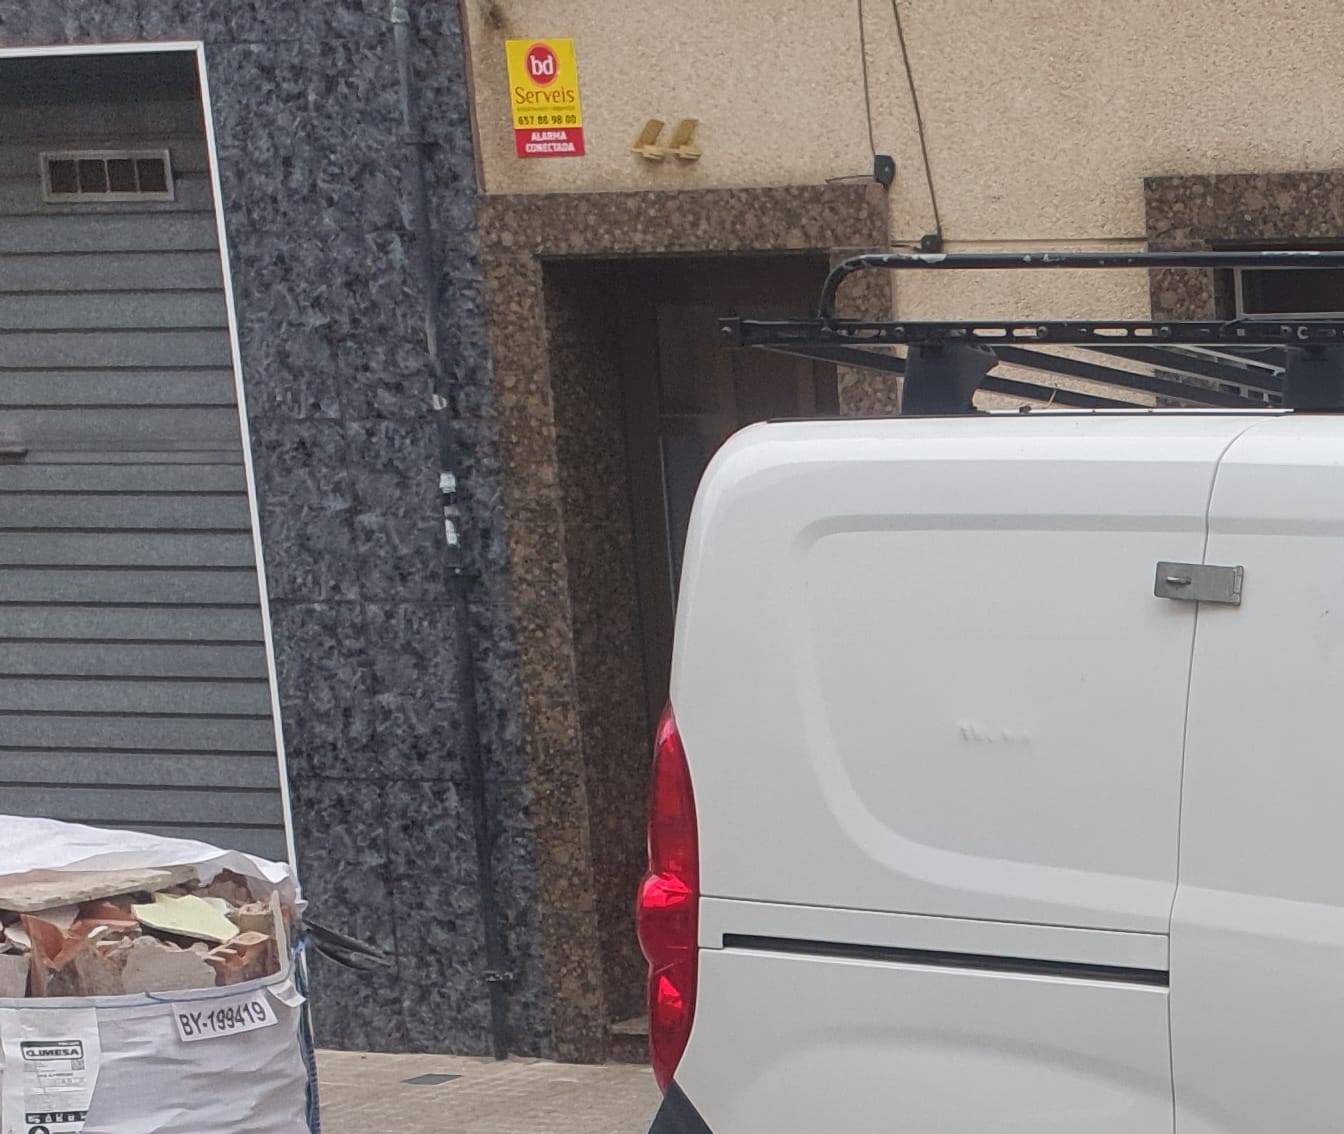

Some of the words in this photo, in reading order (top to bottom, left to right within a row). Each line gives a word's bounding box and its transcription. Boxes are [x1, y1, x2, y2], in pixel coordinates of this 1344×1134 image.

[514, 86, 575, 105] Serveis
[530, 130, 568, 141] ALARMA
[178, 1001, 267, 1036] BY-199419
